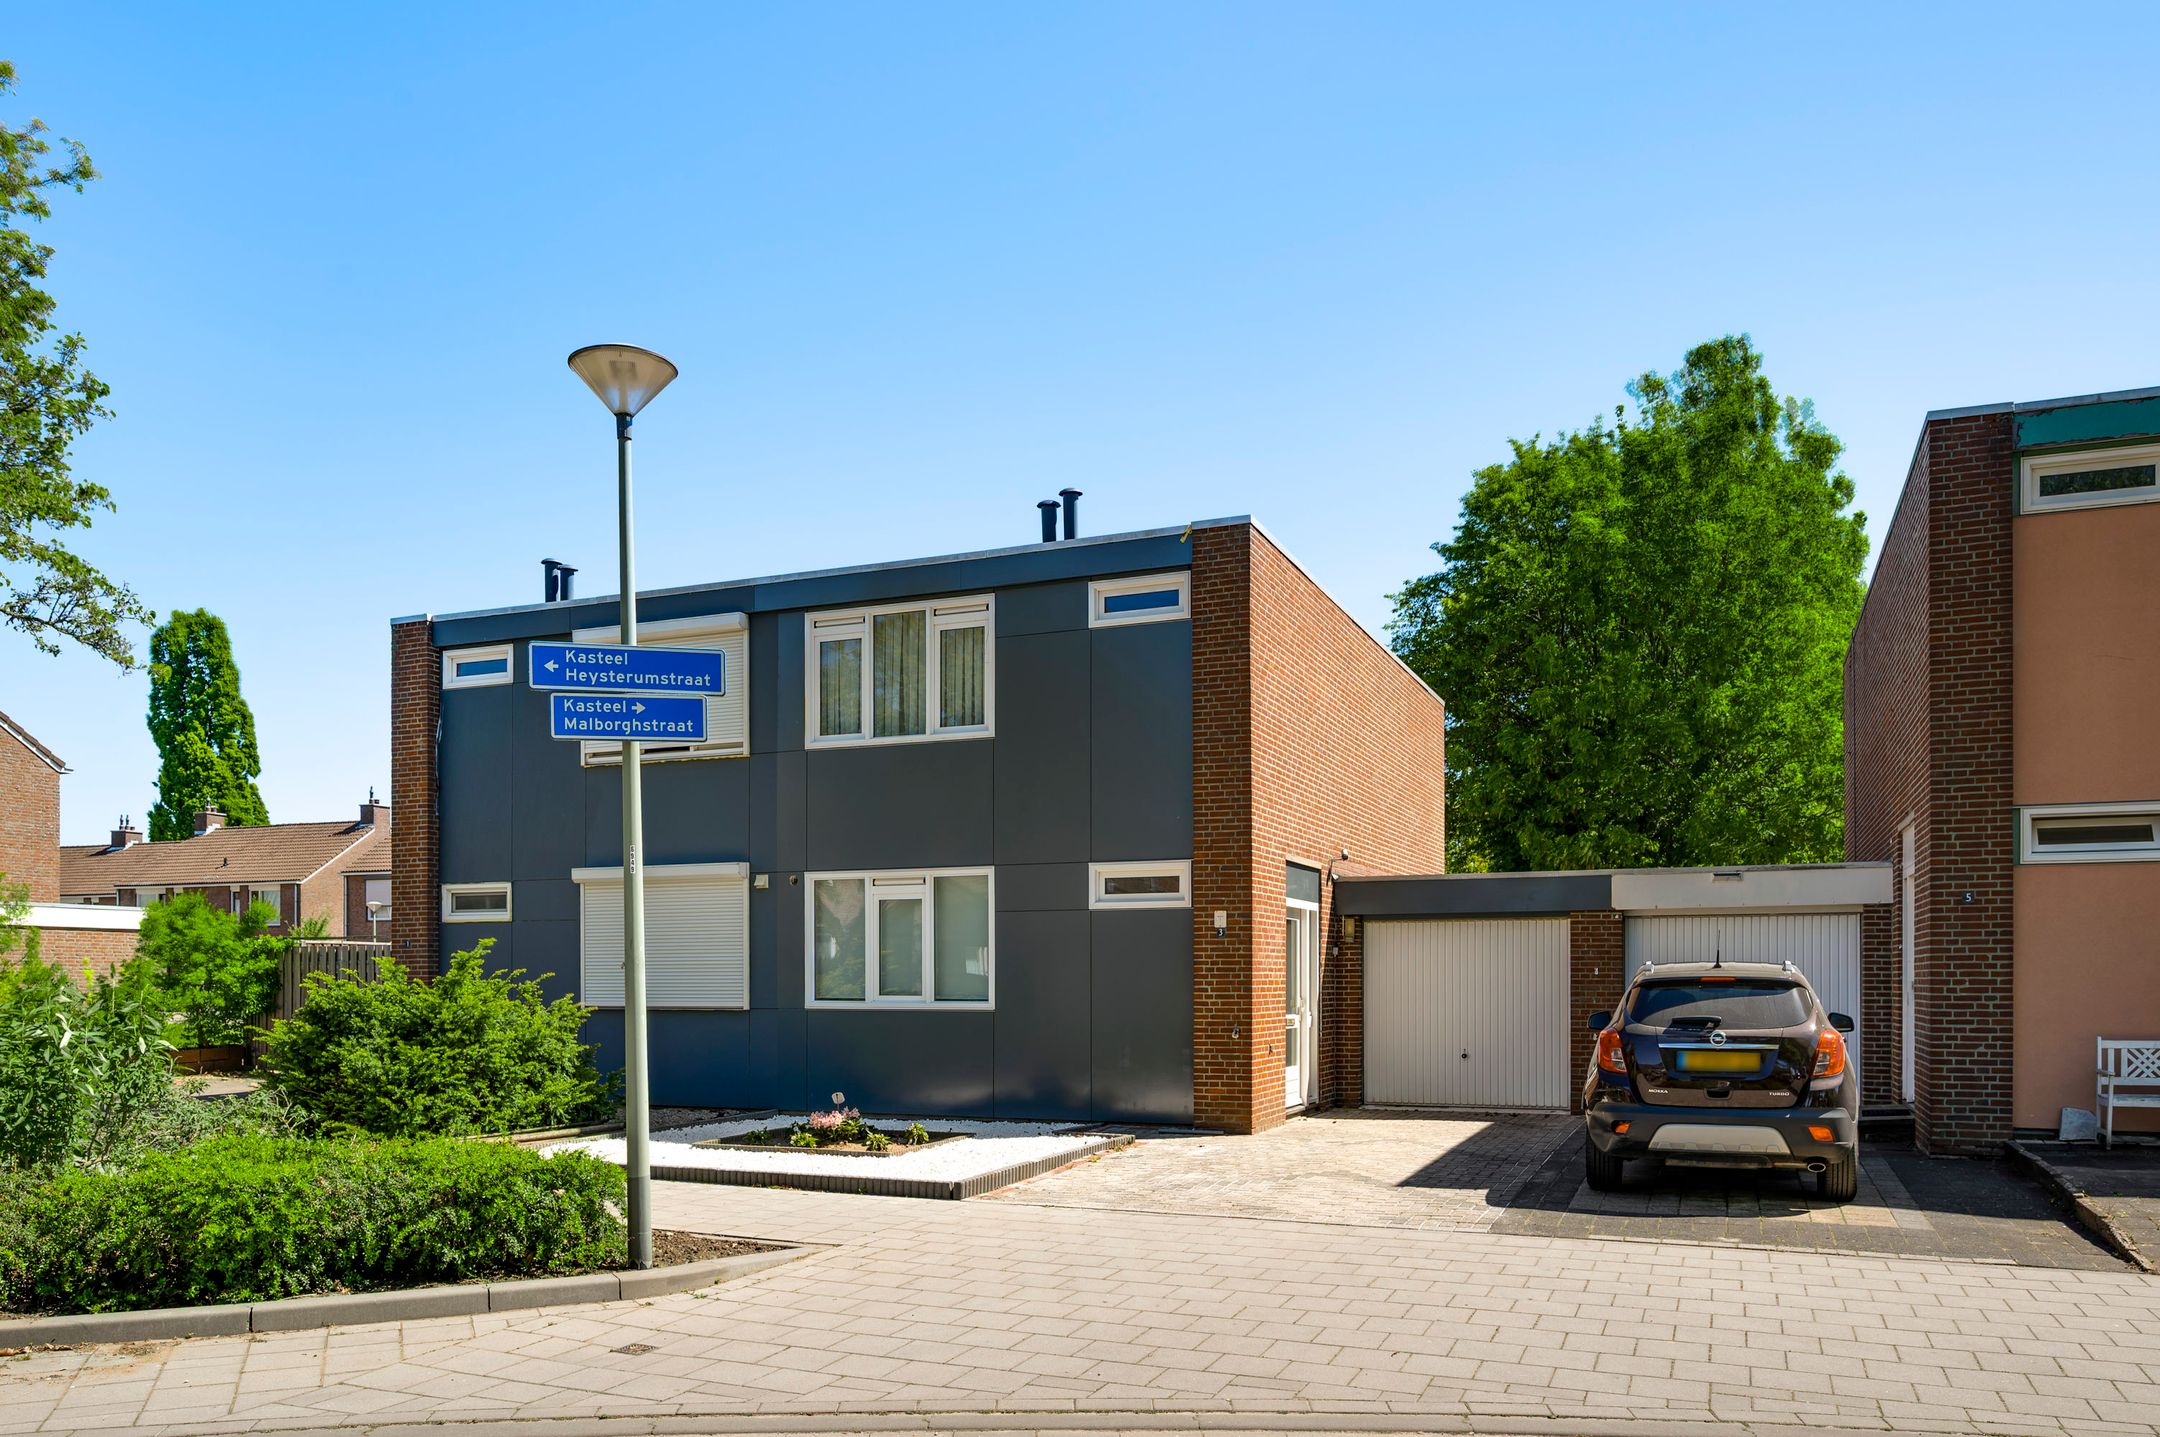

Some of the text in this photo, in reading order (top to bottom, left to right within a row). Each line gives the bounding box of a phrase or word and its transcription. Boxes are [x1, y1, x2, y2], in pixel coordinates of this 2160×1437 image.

[565, 650, 628, 665] Kasteel
[565, 668, 711, 687] Heysterumstraat
[564, 699, 627, 713] Kasteel
[564, 717, 694, 735] Malborghstraat
[1965, 892, 1972, 902] 5
[1218, 928, 1224, 937] 3
